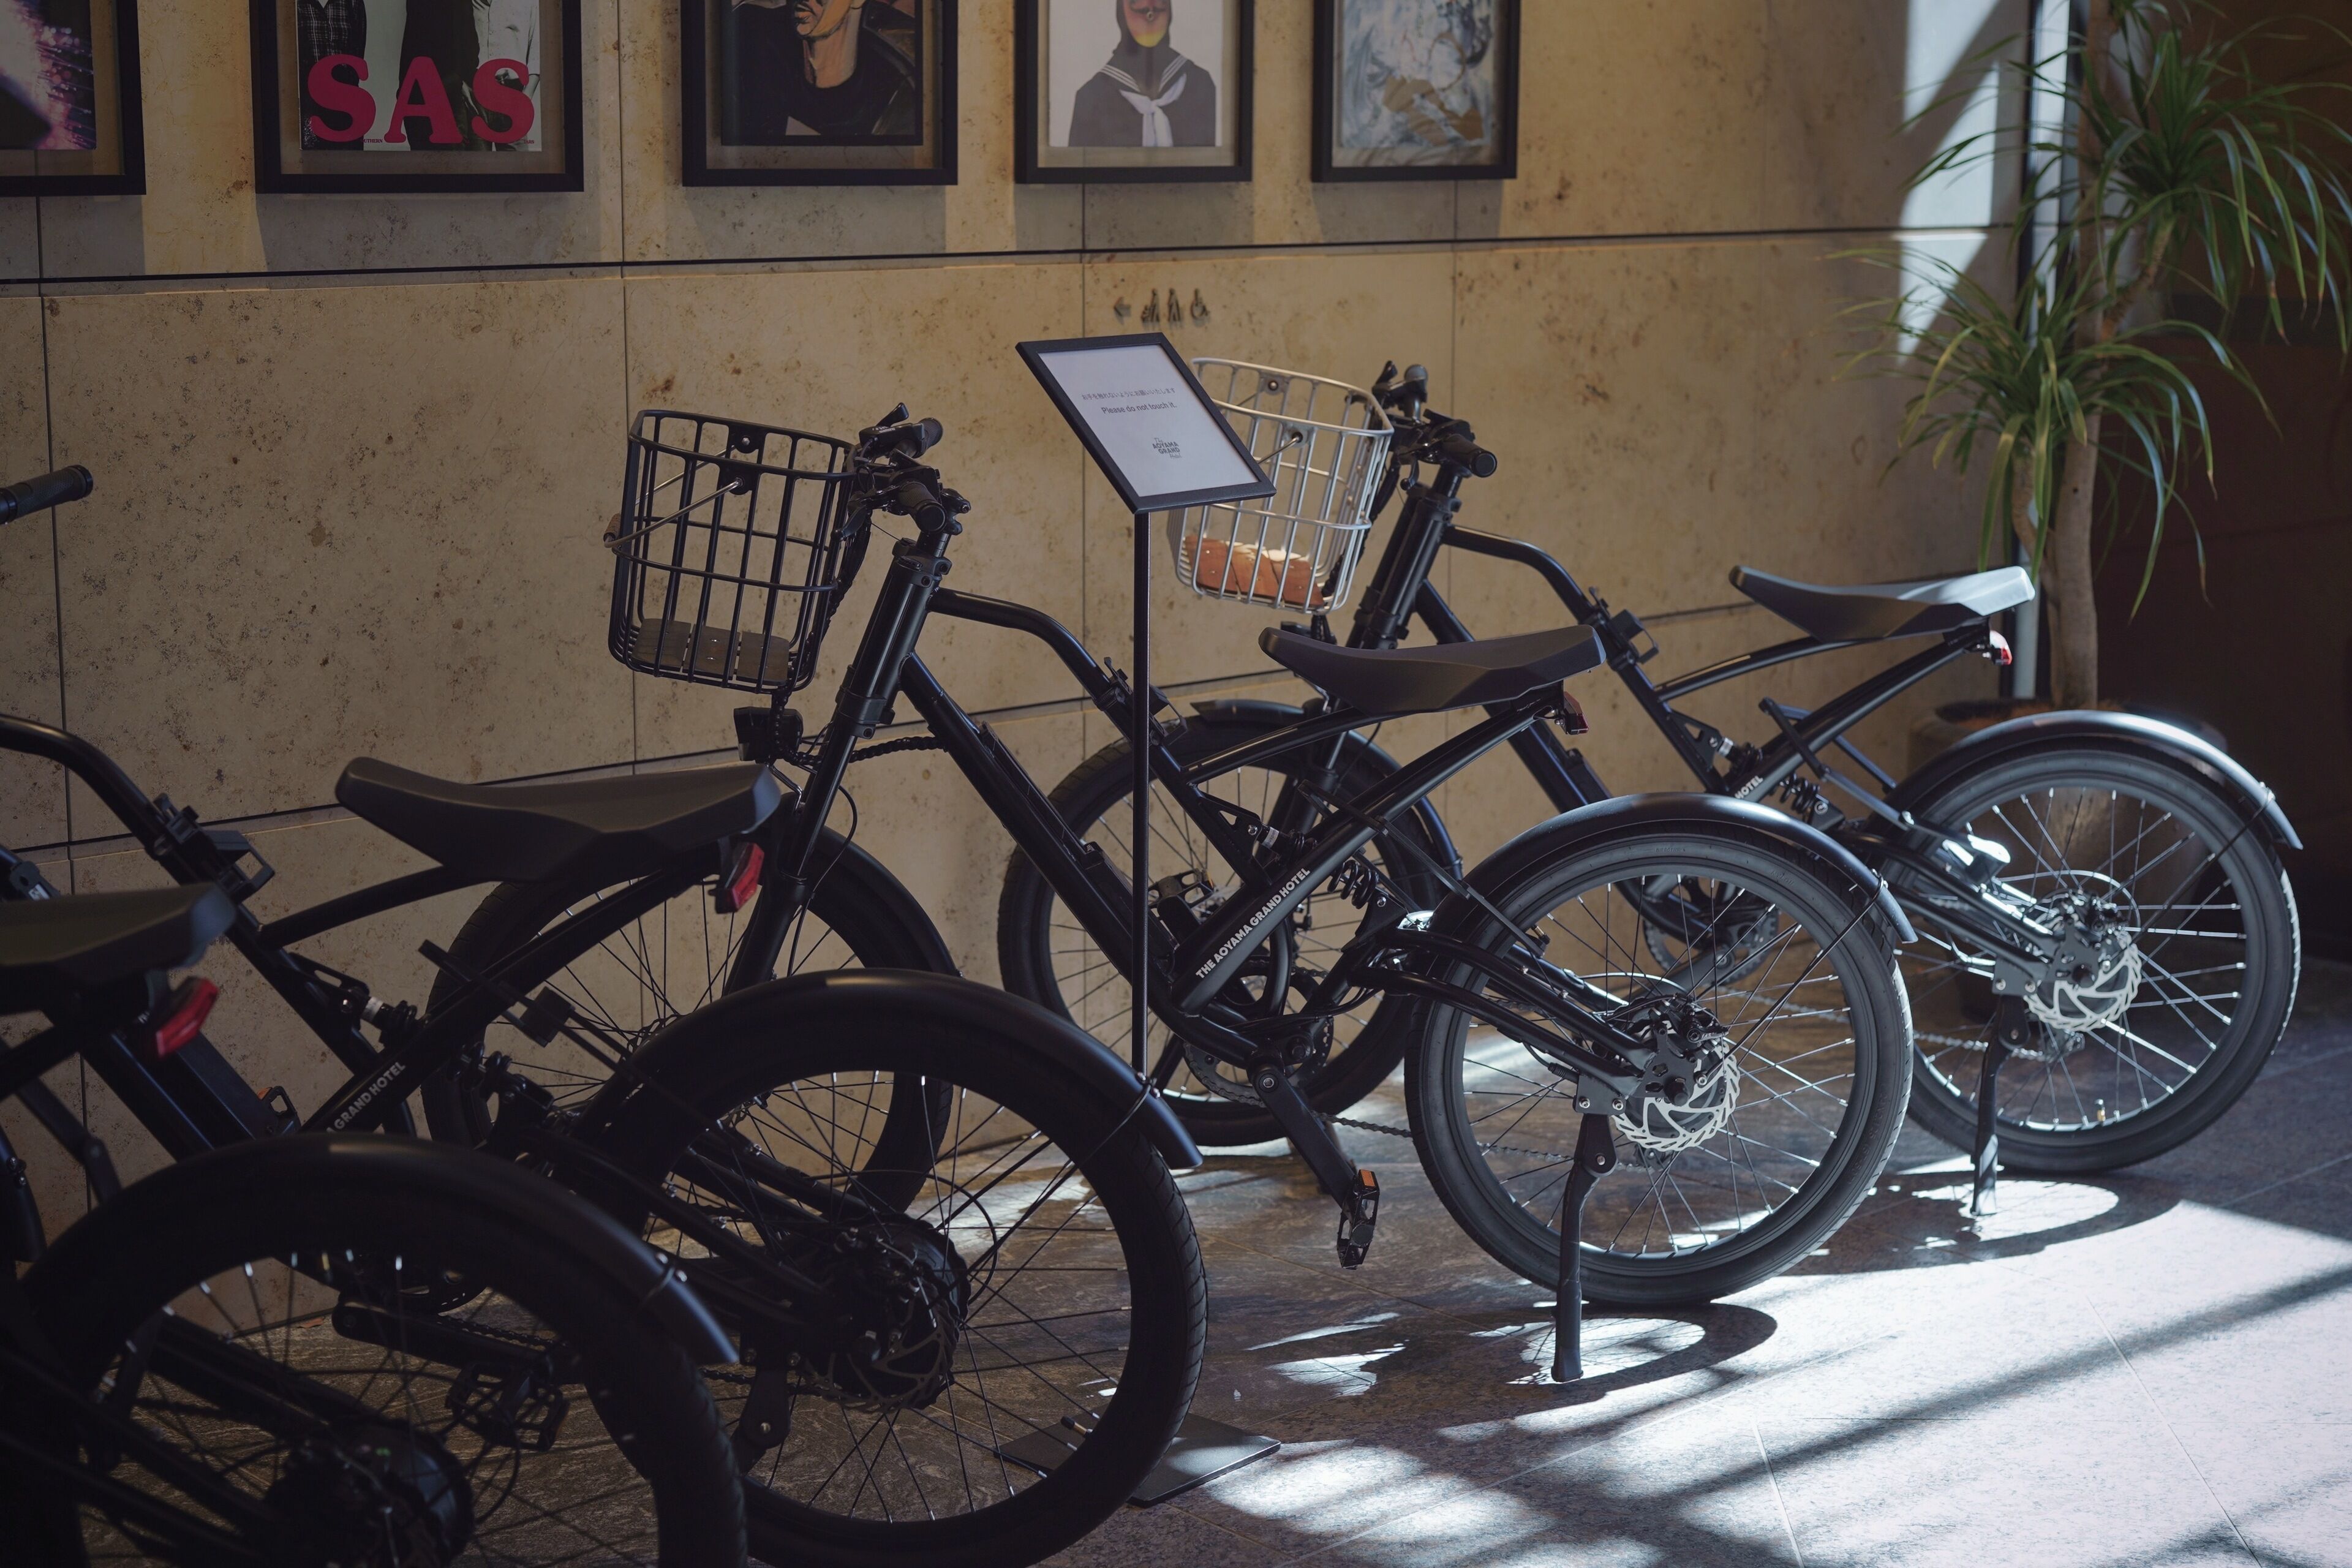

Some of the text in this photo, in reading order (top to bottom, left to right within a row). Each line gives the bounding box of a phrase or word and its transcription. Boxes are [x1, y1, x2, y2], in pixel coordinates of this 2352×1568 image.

[307, 53, 535, 144] SAS
[1734, 775, 1764, 799] HOTEL
[1195, 868, 1311, 979] THE AOYAMA GRAND HOTEL
[334, 1061, 406, 1129] GRAND HOTEL
